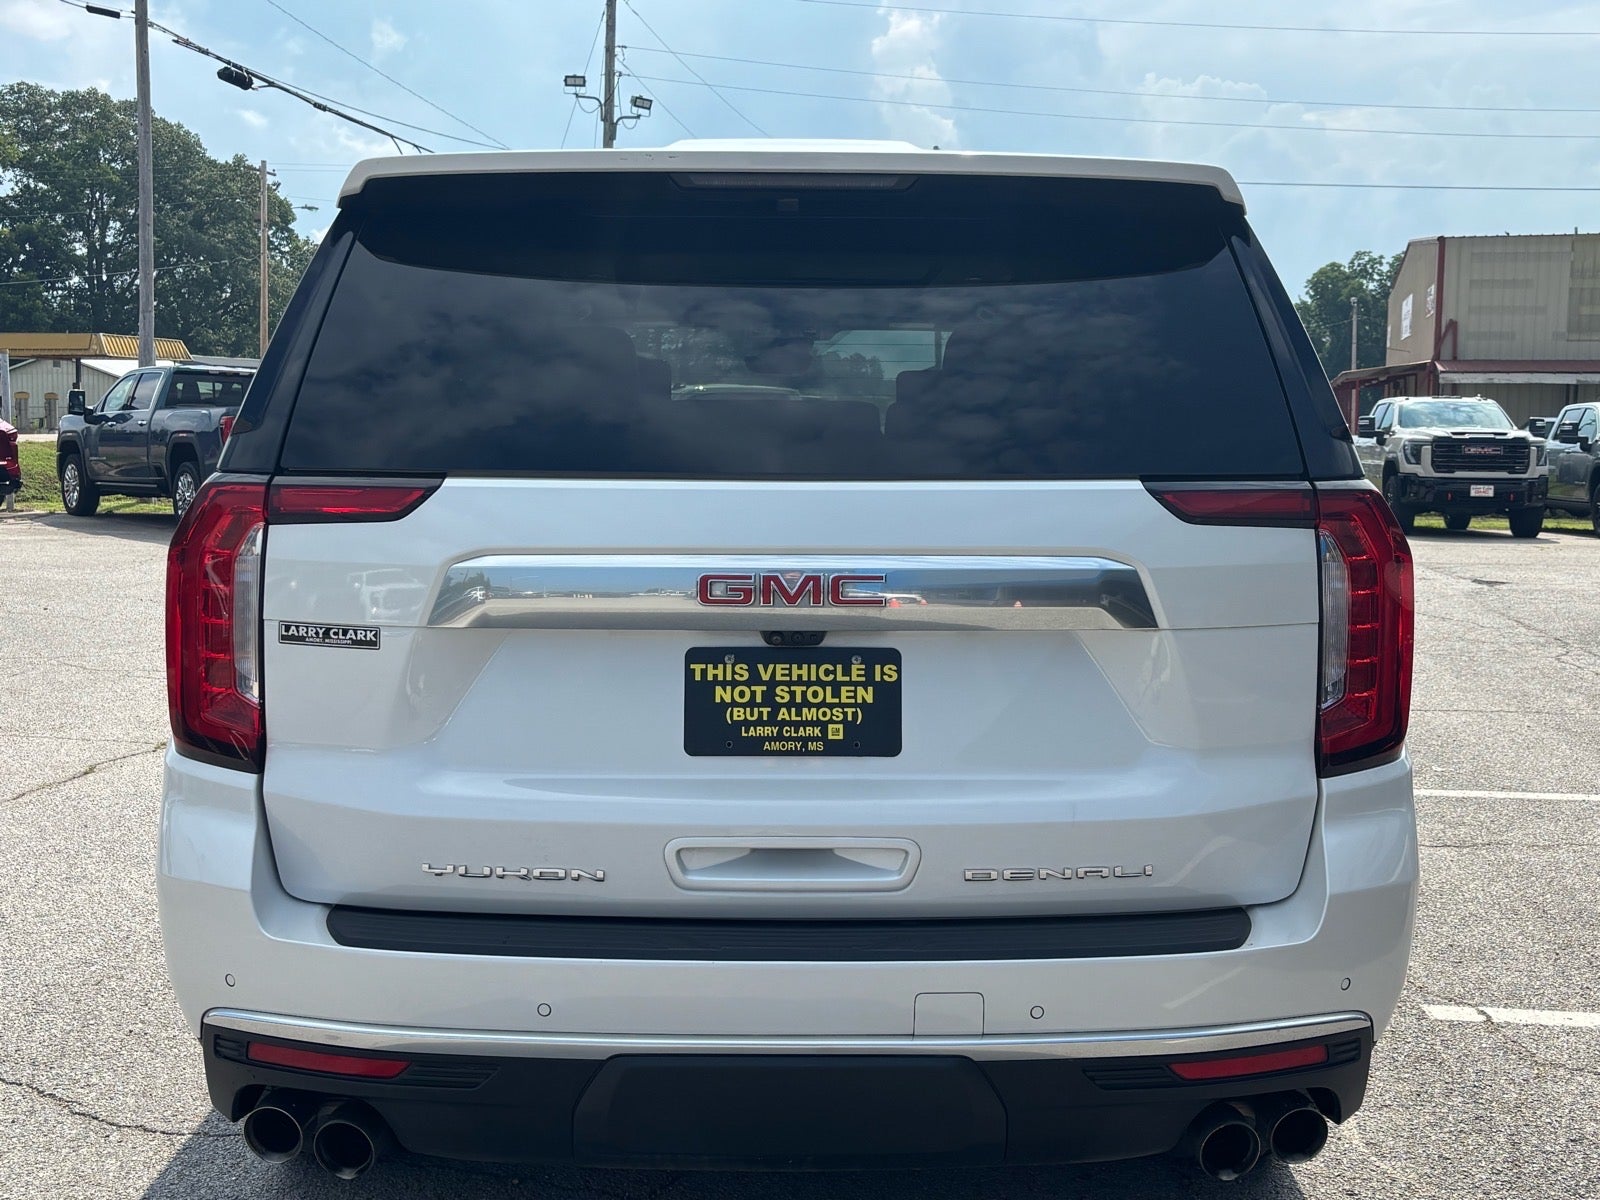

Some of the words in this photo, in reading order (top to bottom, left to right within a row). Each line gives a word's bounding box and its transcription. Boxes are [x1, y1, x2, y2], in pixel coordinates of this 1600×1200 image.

[697, 572, 887, 607] GMC
[281, 624, 326, 638] LARRY
[329, 628, 377, 641] CLARK
[690, 663, 750, 681] THIS
[757, 664, 866, 682] VEHICLE
[874, 664, 899, 682] IS
[715, 685, 767, 703] NOT
[775, 686, 874, 704] STOLEN
[726, 707, 771, 724] (BUT
[777, 707, 863, 724] ALMOST)
[741, 726, 779, 737] LARRY
[783, 726, 822, 737] CLARK
[763, 741, 805, 752] AMORY,
[808, 741, 824, 751] MS
[422, 863, 606, 882] YUKON
[964, 864, 1154, 882] DENALI
